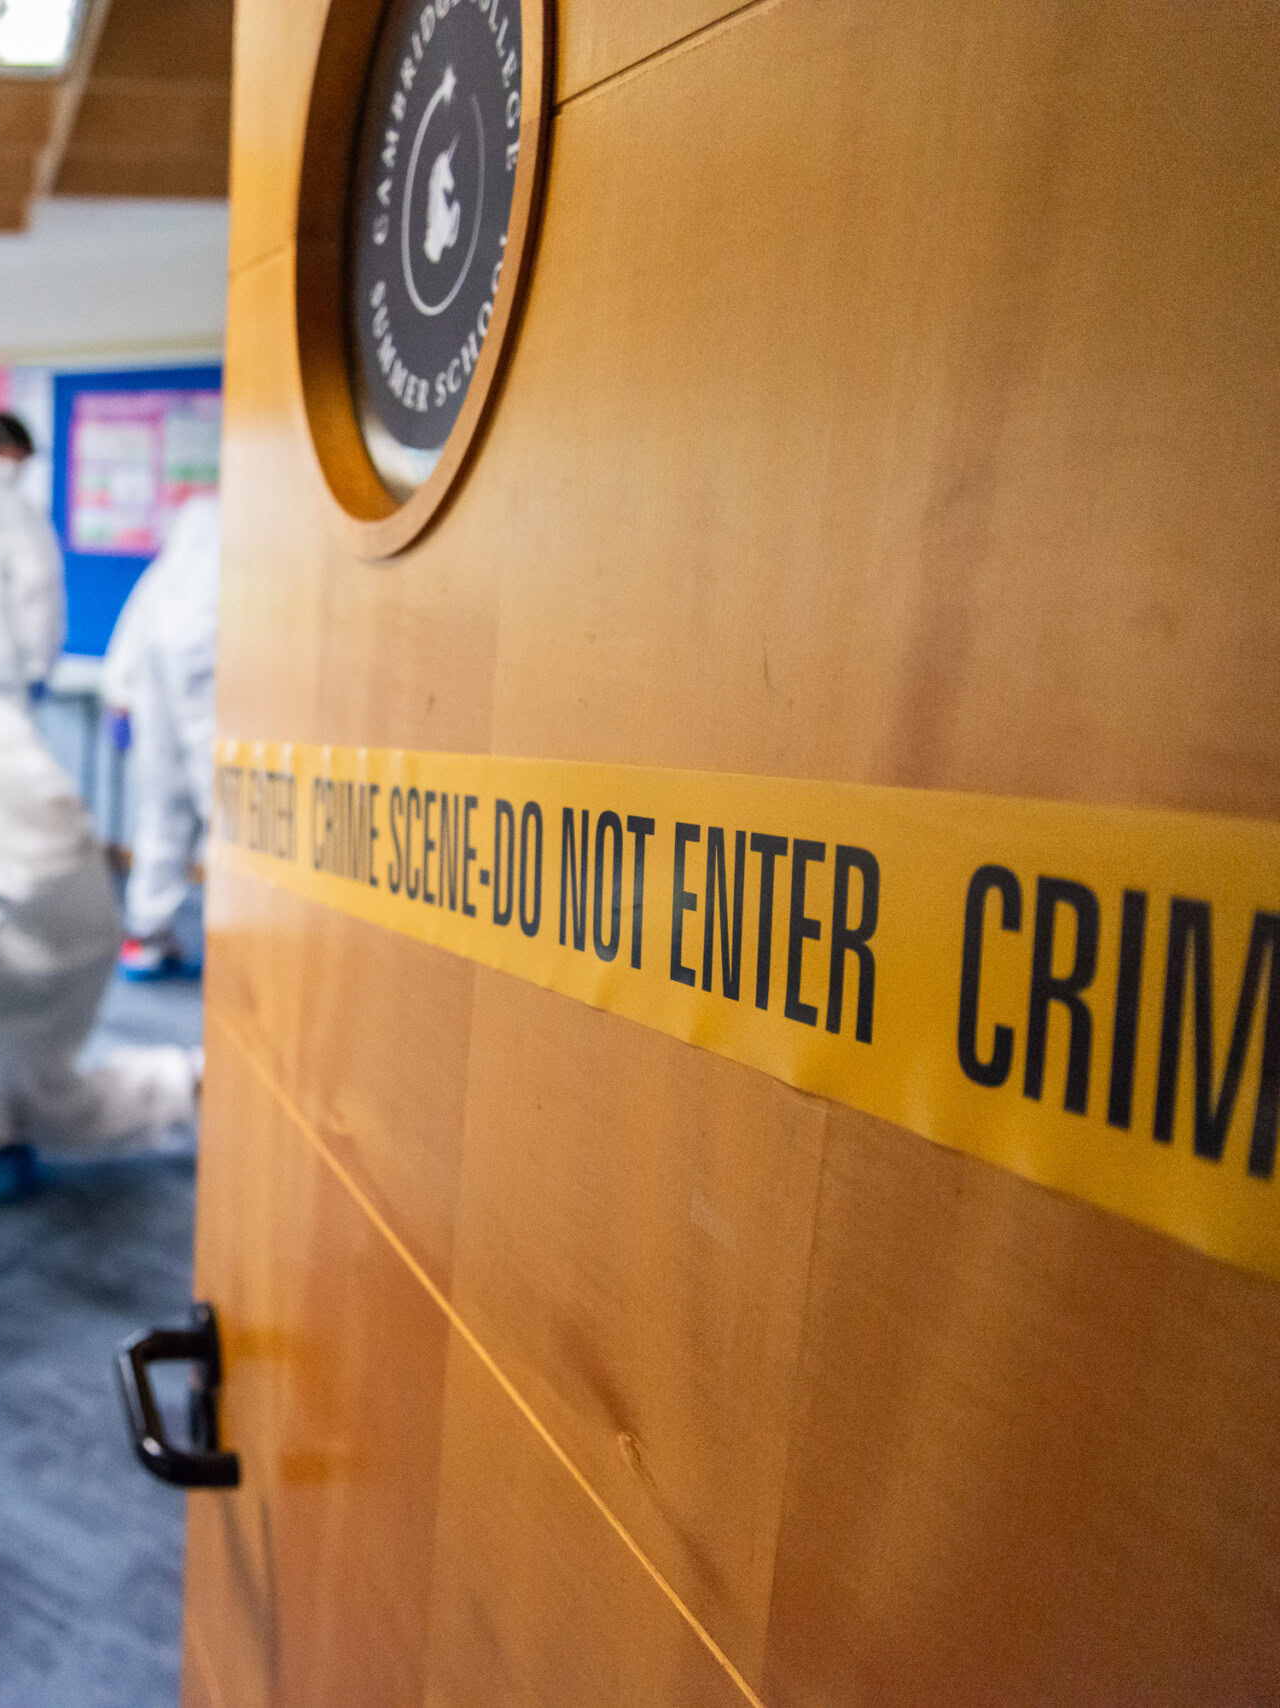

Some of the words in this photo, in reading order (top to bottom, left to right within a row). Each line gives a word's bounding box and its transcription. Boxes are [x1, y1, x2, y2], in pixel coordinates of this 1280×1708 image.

[372, 0, 462, 246] CAMBRID
[469, 0, 522, 172] LLEGE
[370, 280, 430, 412] SUMMER
[434, 234, 508, 408] SCHOO
[314, 776, 380, 889] CRIME
[559, 806, 656, 971] NOT
[670, 821, 881, 1046] ENTER
[957, 863, 1280, 1182] CRIM
